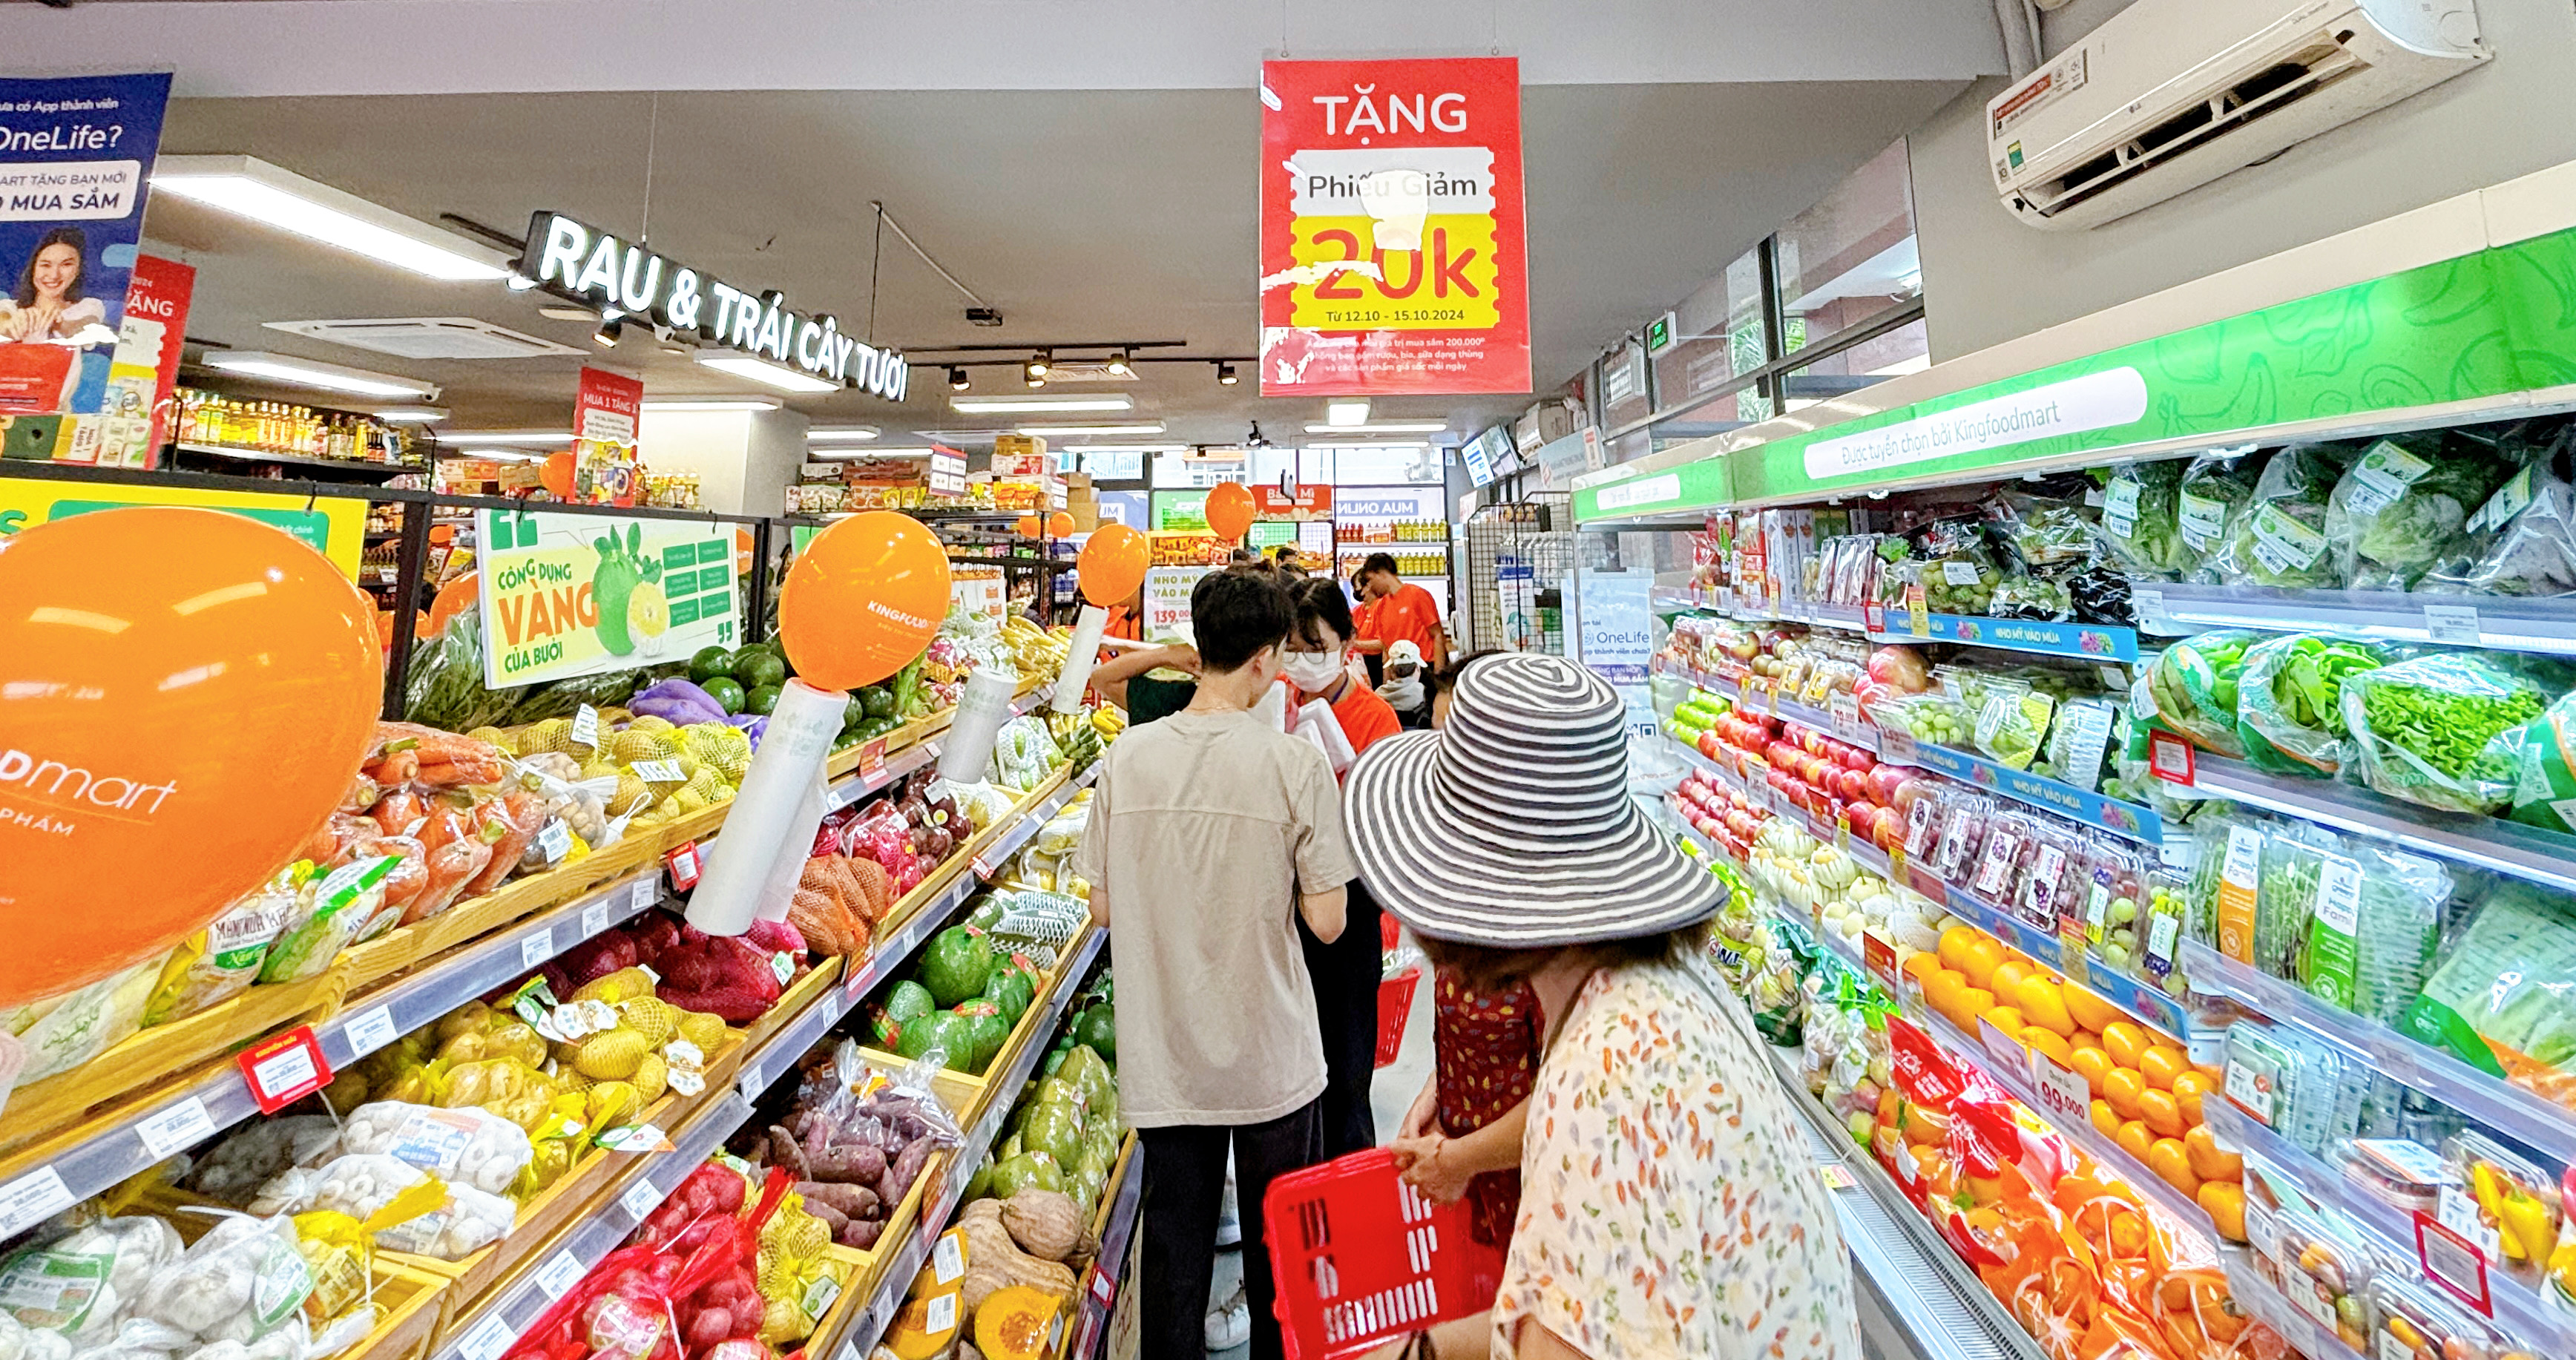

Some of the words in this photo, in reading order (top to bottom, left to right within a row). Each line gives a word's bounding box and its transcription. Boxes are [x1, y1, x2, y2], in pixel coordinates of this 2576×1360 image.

[33, 101, 59, 113] App
[1312, 83, 1467, 145] TẶNG
[1, 175, 27, 185] ART
[30, 173, 67, 188] TẶNG
[70, 174, 98, 187] BẠN
[102, 171, 127, 184] MỚI
[11, 194, 62, 211] MUA
[70, 186, 120, 210] SẮM
[1312, 227, 1479, 300] 20k
[128, 289, 174, 317] ẶNG
[539, 214, 660, 312] RAU
[667, 268, 700, 329] &
[713, 281, 798, 361] TRÁI
[798, 315, 853, 381] CÂY
[853, 341, 908, 401] TƯƠI
[1326, 309, 1342, 322] Từ
[1345, 310, 1380, 322] 12.10
[1394, 309, 1465, 321] 15.10.2024
[1315, 350, 1335, 361] hông
[1458, 350, 1484, 361] thùng
[583, 393, 603, 406] MUA
[605, 398, 611, 407] 1
[1902, 433, 1929, 456] chọn
[1931, 422, 1952, 447] bởi
[1955, 400, 2062, 443] Kingfoodmart
[1301, 487, 1315, 499] Mì
[498, 558, 536, 591] CÔNG
[539, 563, 572, 585] DỤNG
[1153, 576, 1178, 585] NHO
[1153, 587, 1176, 598] VÀO
[498, 578, 599, 646] VÀNG
[1597, 631, 1650, 643] OneLife
[1995, 628, 2011, 640] NHO
[2024, 628, 2041, 643] VÀO
[2042, 631, 2061, 645] MÙA
[505, 646, 531, 673] CỦA
[0, 749, 179, 814] Dmart
[2012, 779, 2031, 794] NHO
[2042, 1081, 2085, 1120] 99.000
